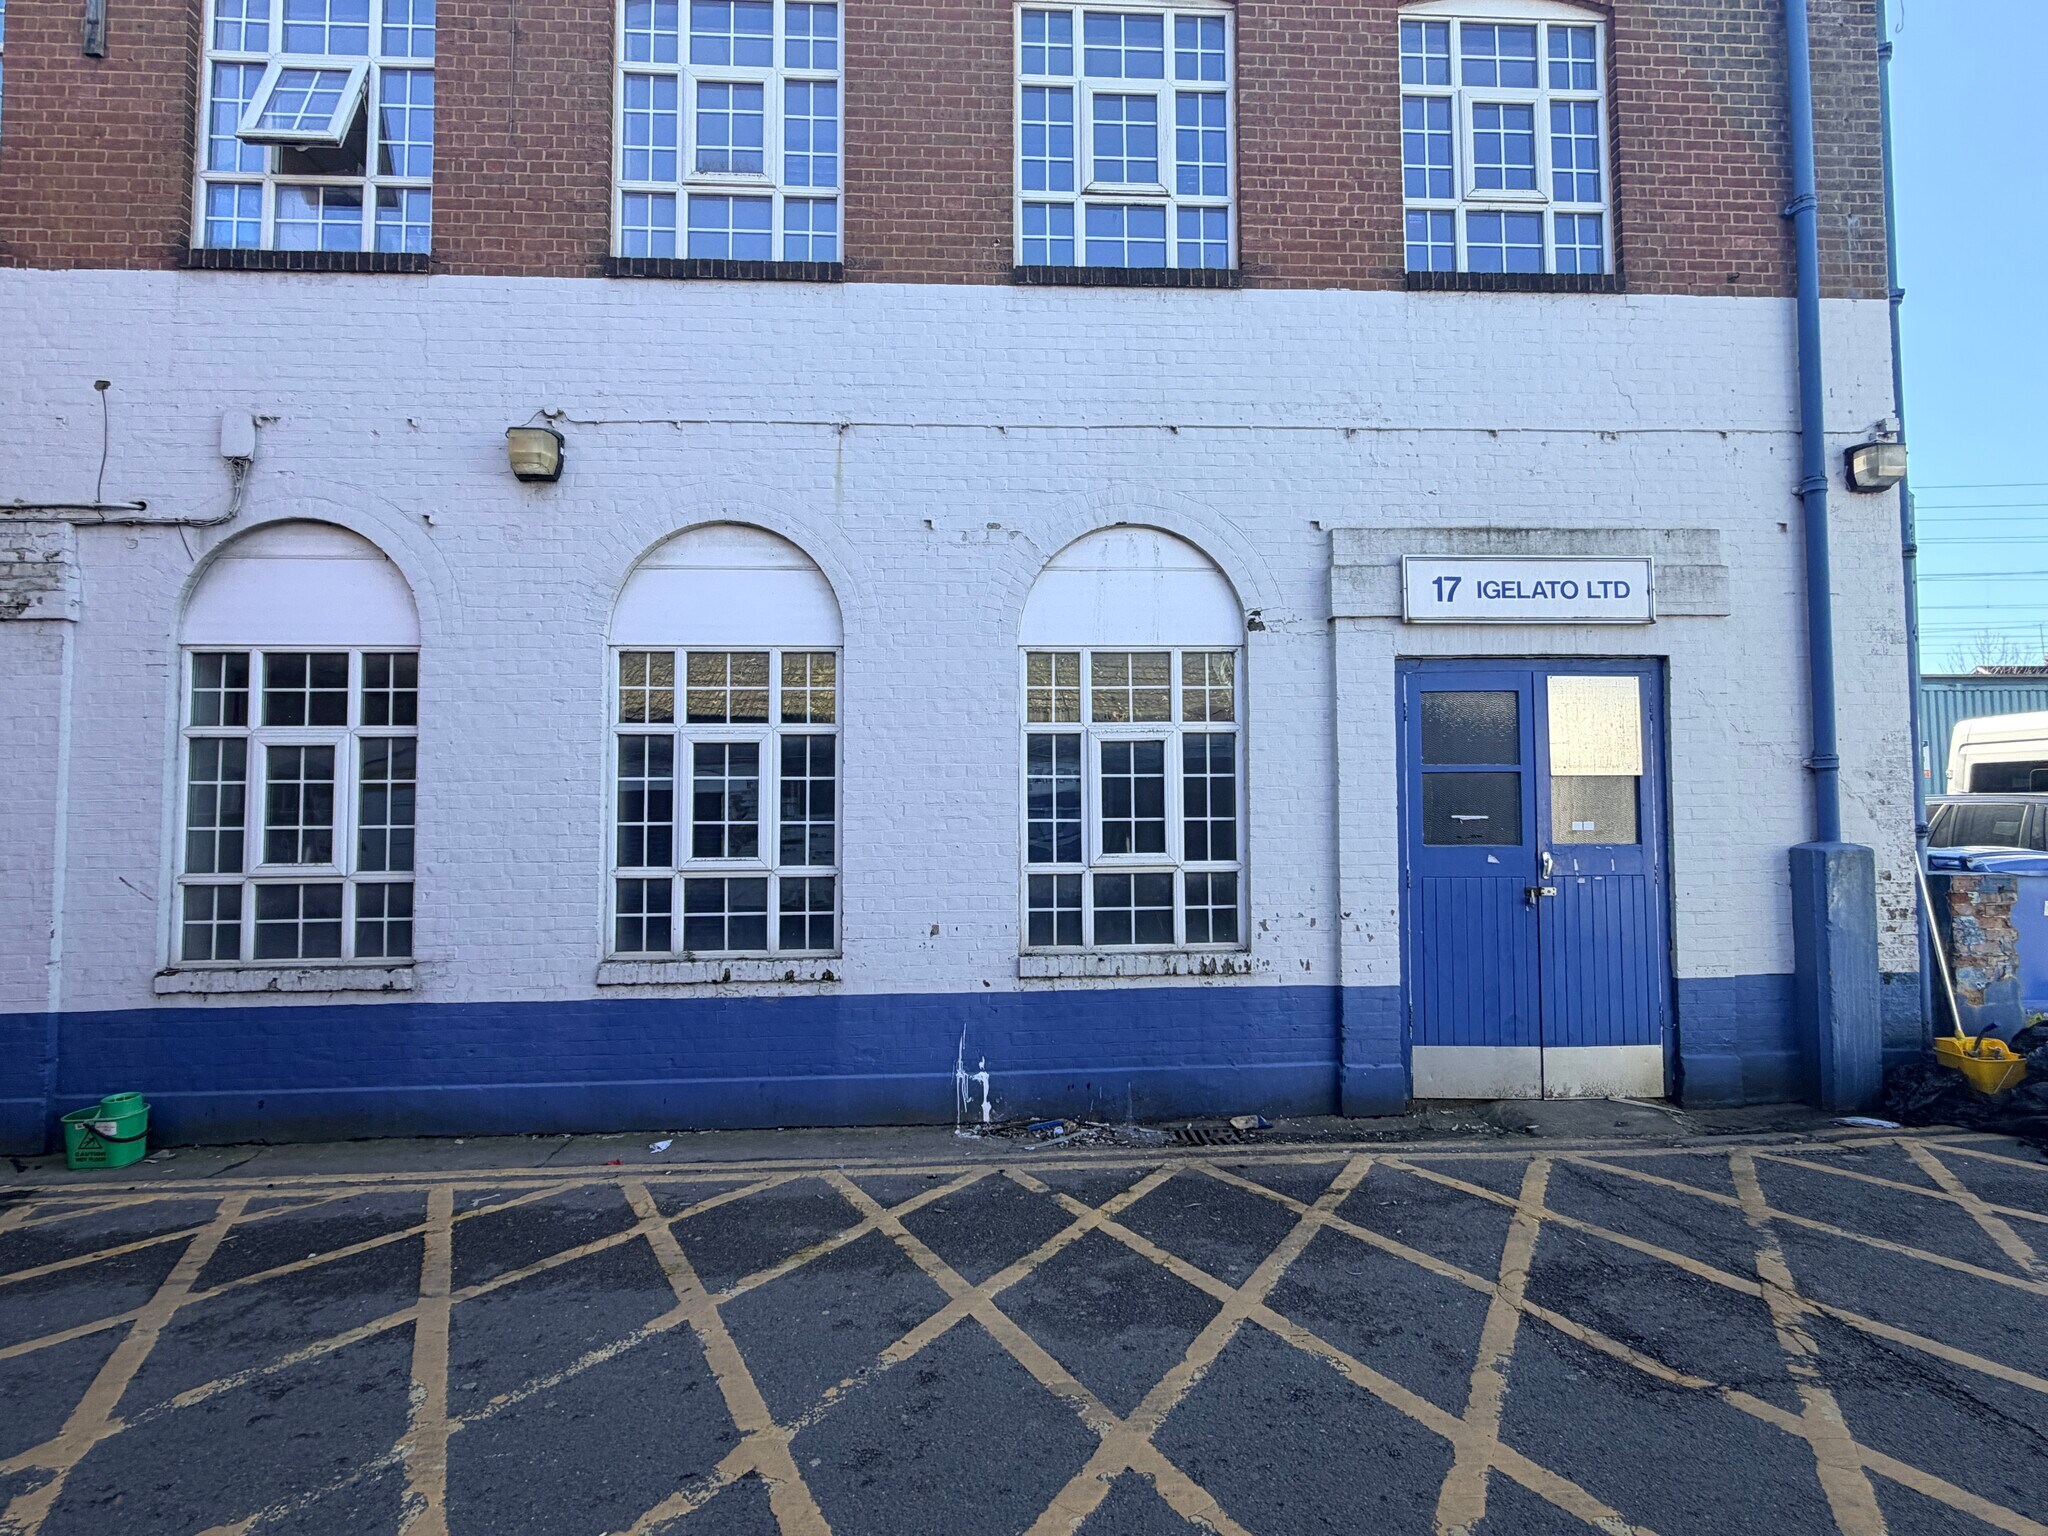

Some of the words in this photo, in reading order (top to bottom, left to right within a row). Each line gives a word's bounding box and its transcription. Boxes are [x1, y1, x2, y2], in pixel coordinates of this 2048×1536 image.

[1432, 576, 1462, 602] 17
[1476, 580, 1579, 600] IGELATO
[1587, 580, 1631, 599] LTD
